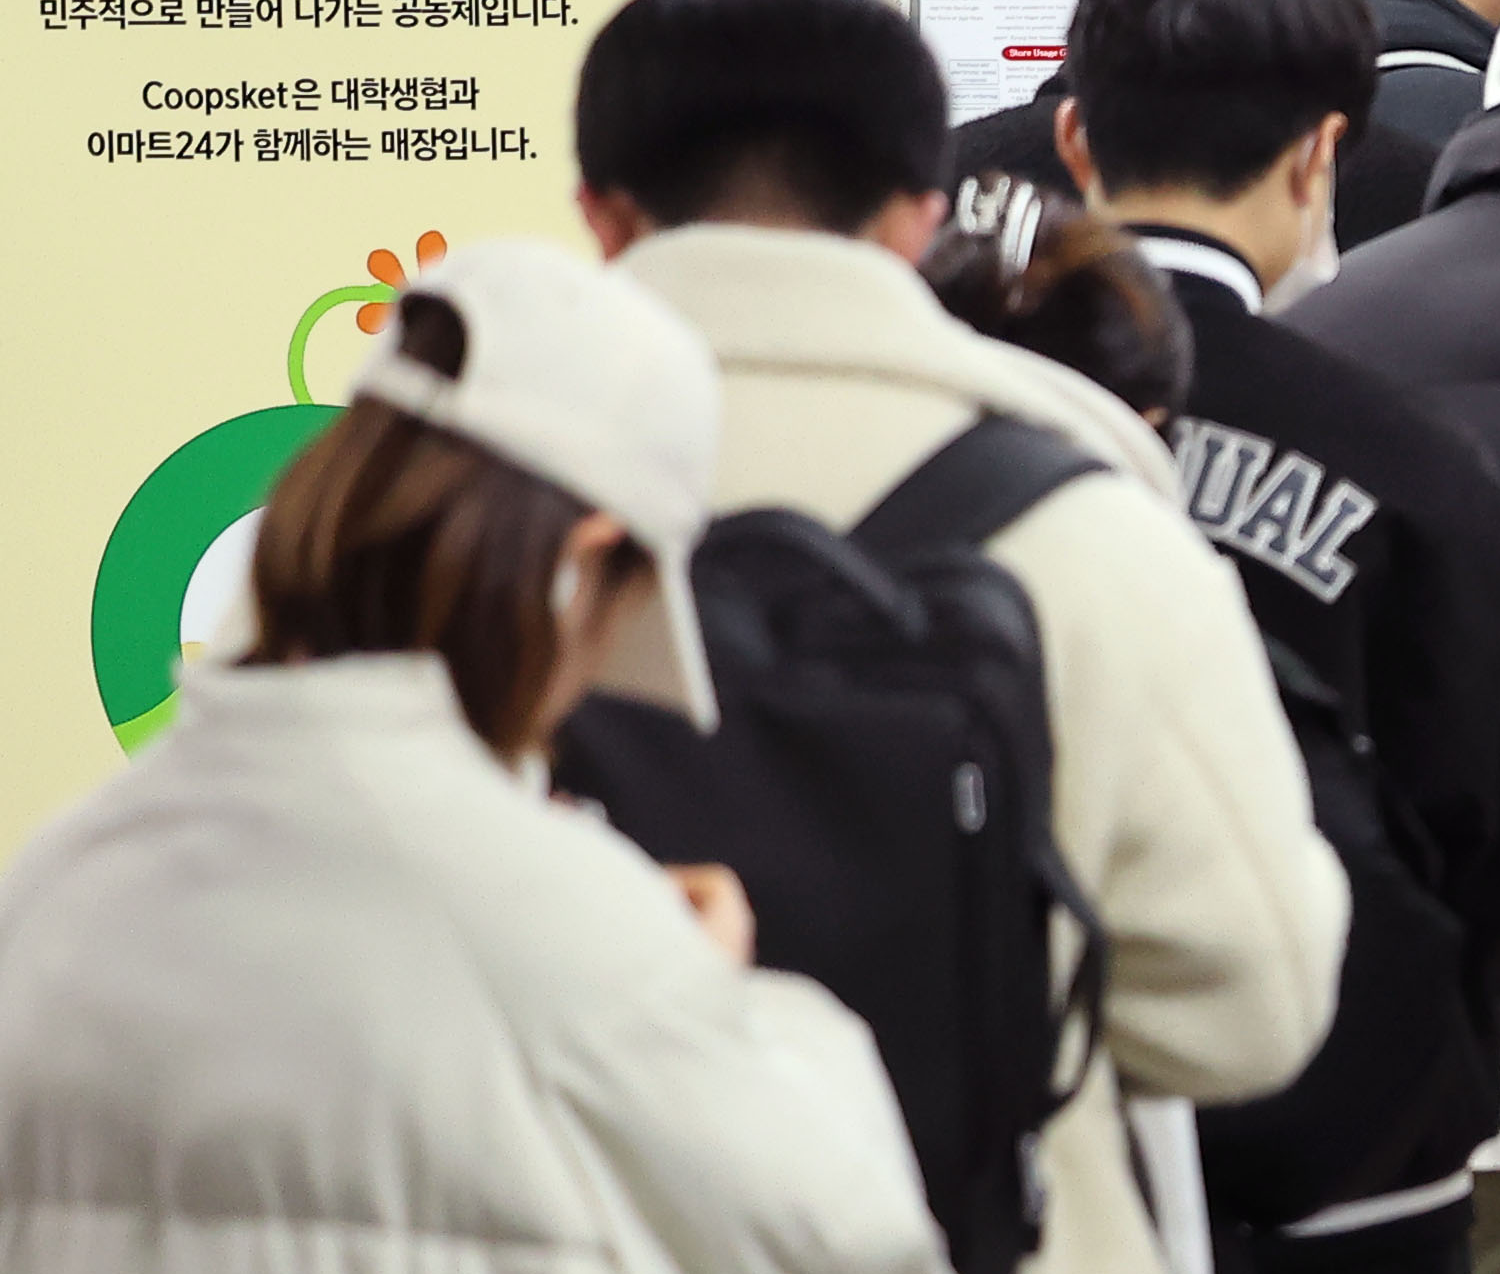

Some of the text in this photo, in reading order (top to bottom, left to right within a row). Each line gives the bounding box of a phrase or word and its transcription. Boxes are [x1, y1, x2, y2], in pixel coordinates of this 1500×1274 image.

[143, 77, 479, 115] Coopsket은 대학생협과
[88, 127, 536, 163] 이마트24가 함께하는 매장입니다.
